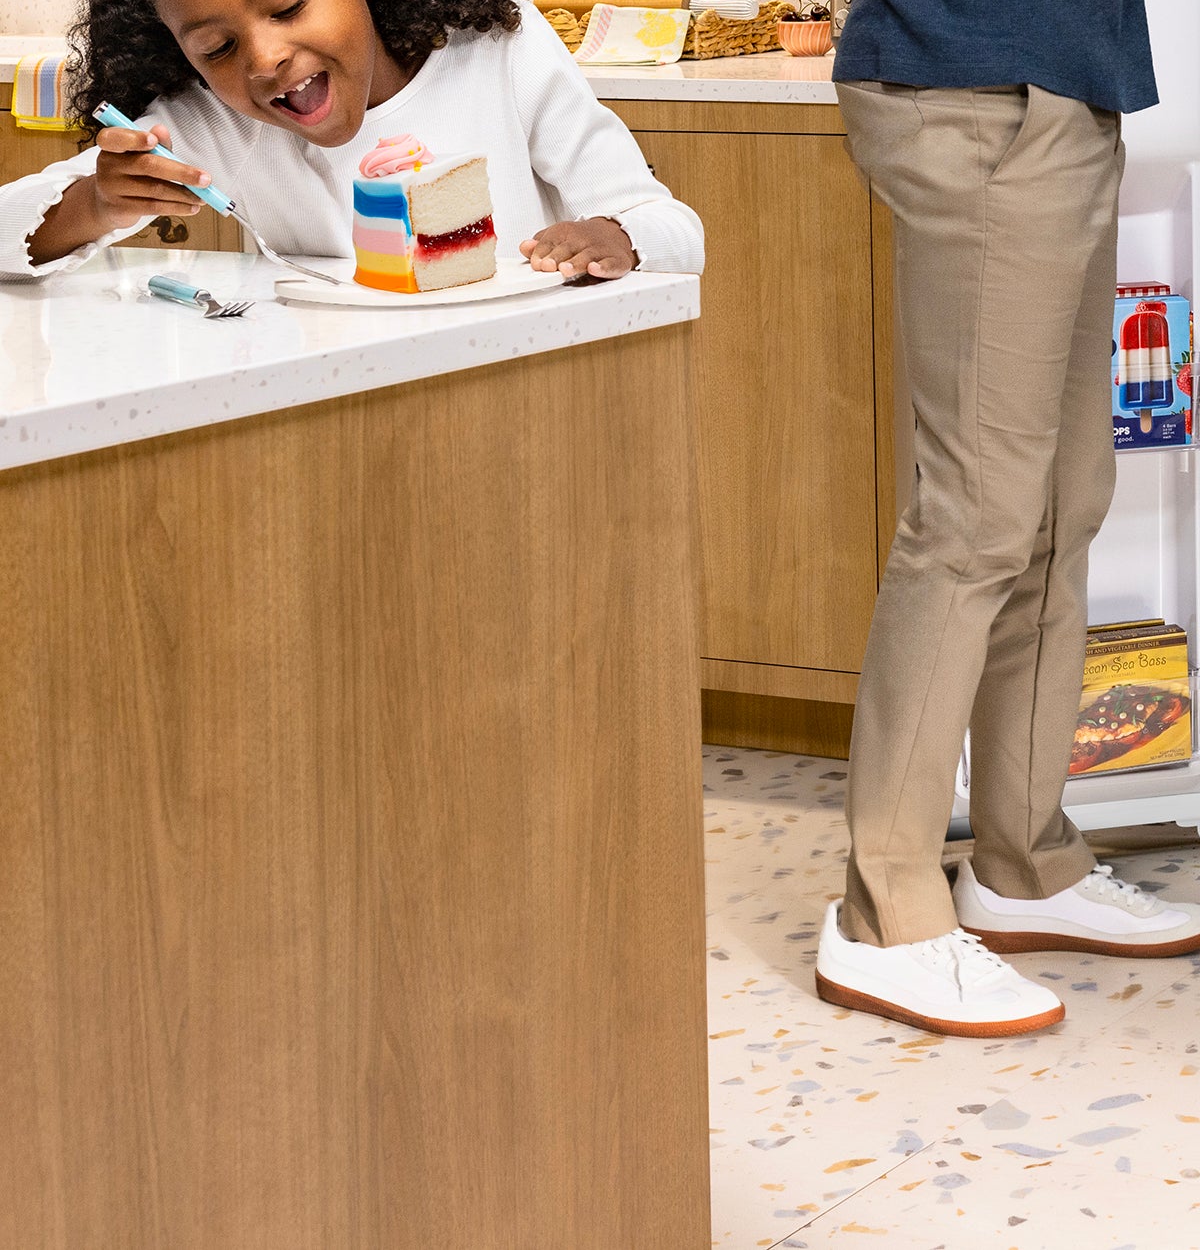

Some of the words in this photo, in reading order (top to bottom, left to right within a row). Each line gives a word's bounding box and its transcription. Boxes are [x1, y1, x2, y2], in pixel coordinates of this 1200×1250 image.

[1137, 641, 1160, 650] DINNER
[1111, 655, 1135, 674] Sea
[1138, 652, 1167, 668] Bass
